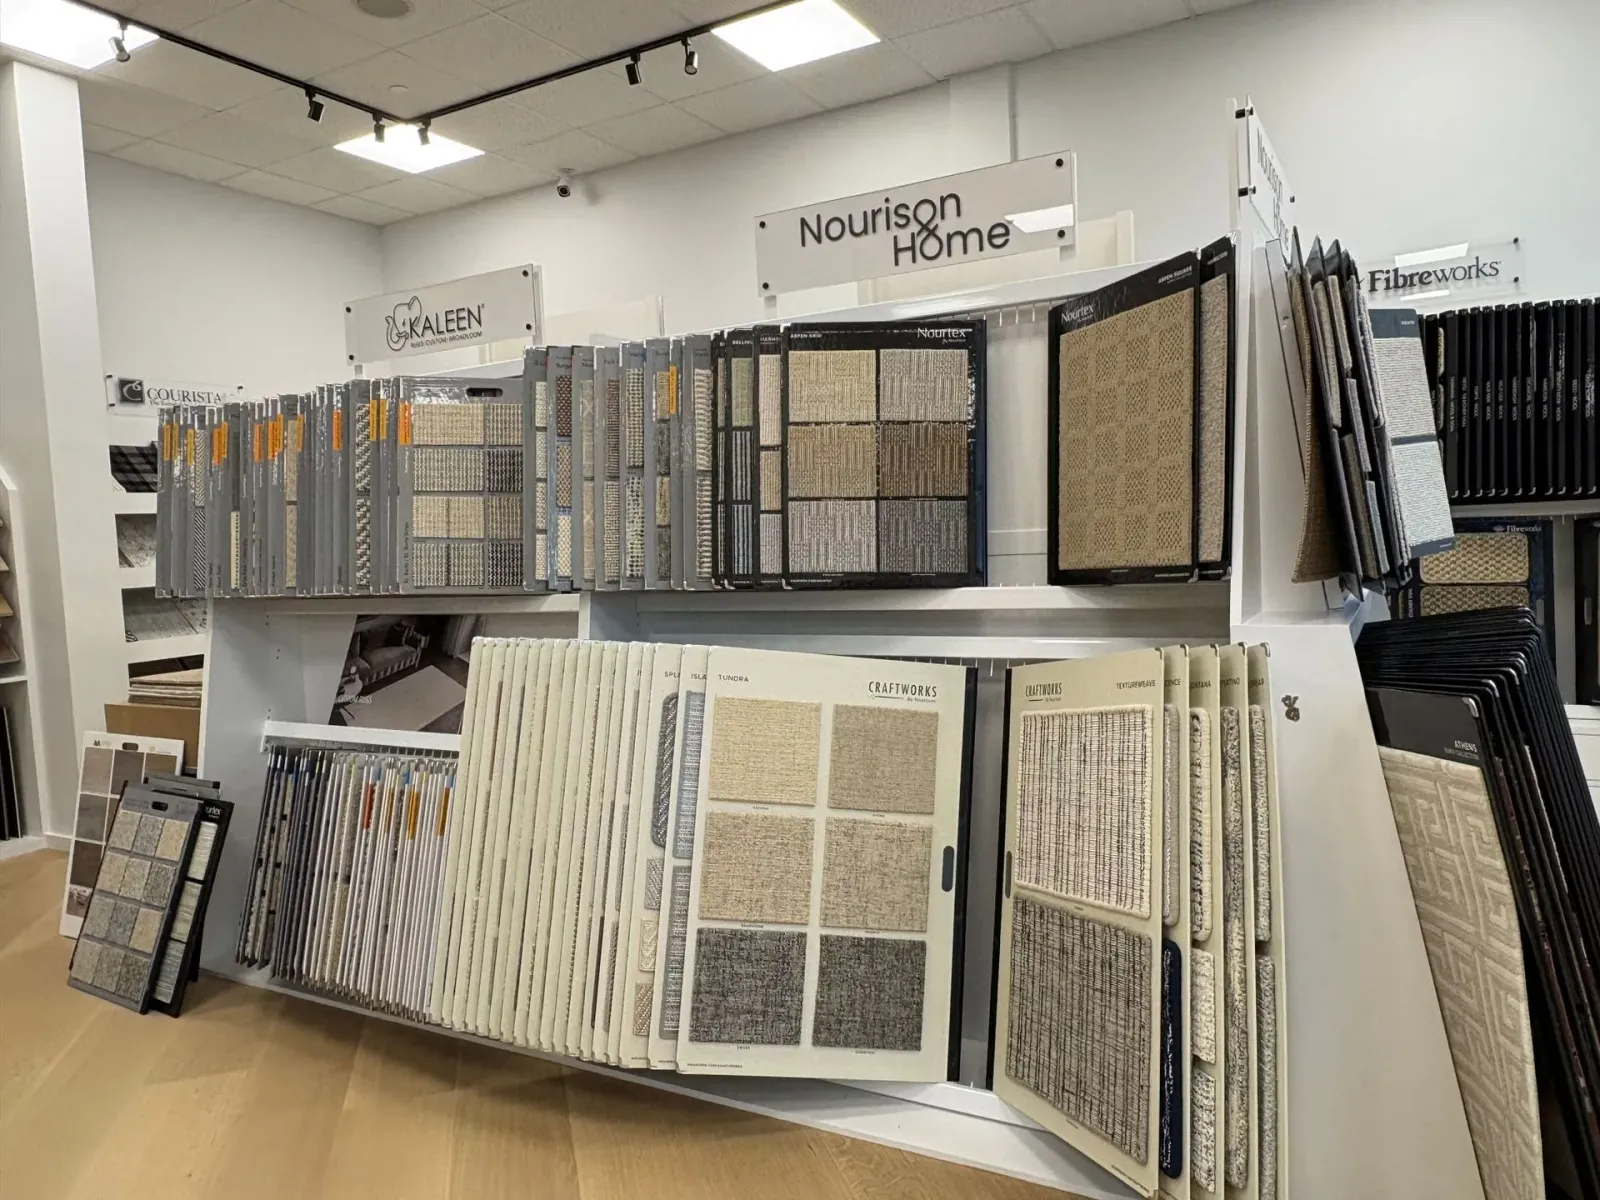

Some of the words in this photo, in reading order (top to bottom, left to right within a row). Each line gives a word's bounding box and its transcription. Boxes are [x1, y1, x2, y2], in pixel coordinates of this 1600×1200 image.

[799, 192, 962, 247] Nourison
[892, 221, 1011, 266] Home
[1368, 255, 1500, 292] Fibreworks
[408, 303, 483, 339] KALEEN
[917, 327, 967, 338] Nourtex
[718, 674, 749, 682] TUNDRA
[868, 681, 937, 697] CRAFTWORKS
[1025, 682, 1063, 697] CRAFTWORKS
